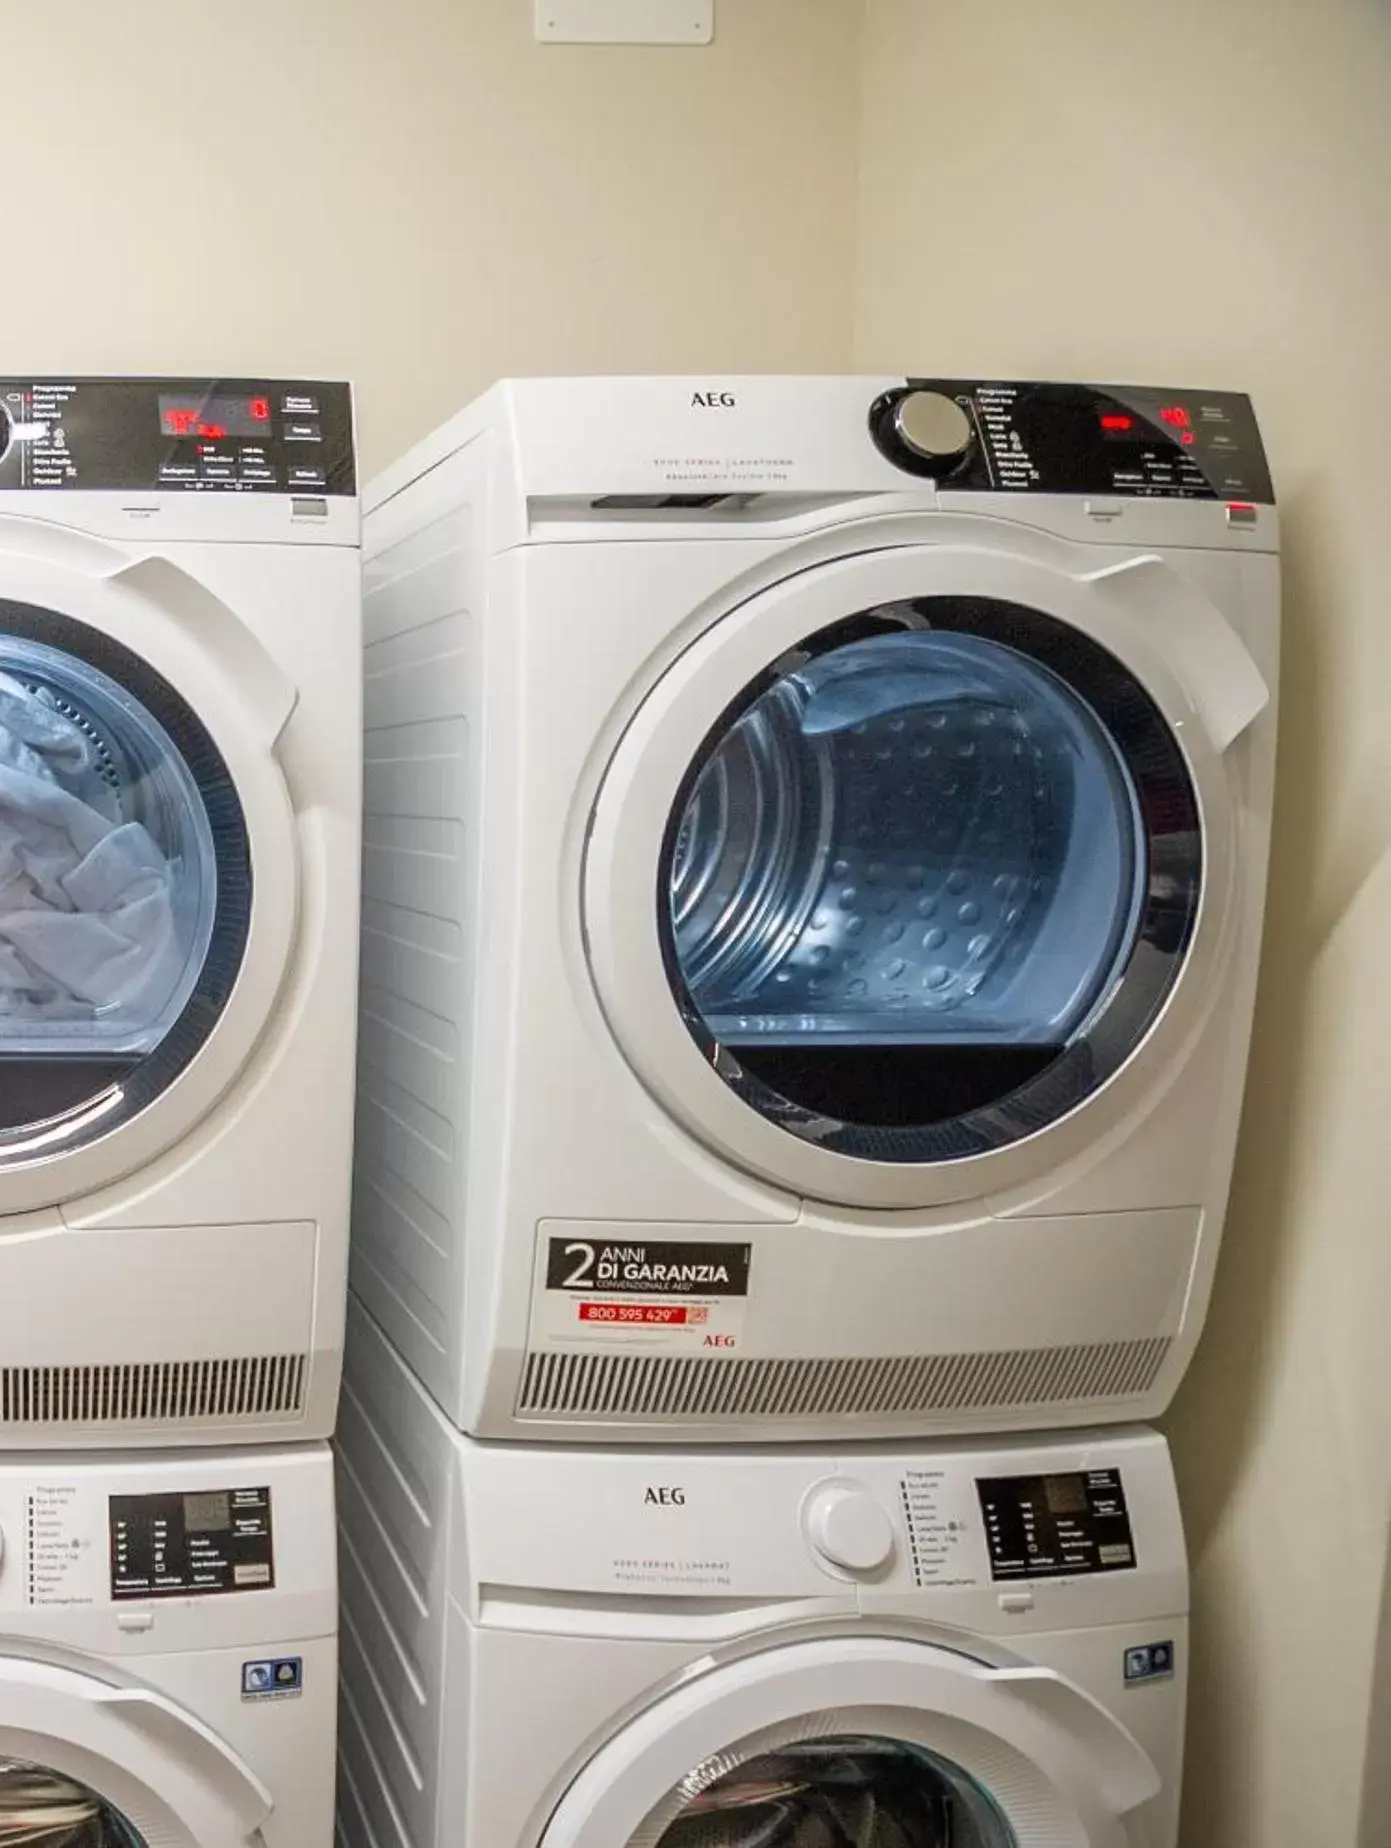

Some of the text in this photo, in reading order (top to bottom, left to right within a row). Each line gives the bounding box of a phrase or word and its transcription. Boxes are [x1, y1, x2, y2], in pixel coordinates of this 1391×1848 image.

[691, 392, 736, 407] AEG
[599, 1247, 646, 1263] ANNI
[562, 1242, 595, 1288] 2
[597, 1263, 730, 1283] DI GARANZIA
[587, 1307, 615, 1319] 800
[618, 1308, 643, 1320] 595
[702, 1335, 735, 1348] AEG
[644, 1487, 686, 1506] AEG
